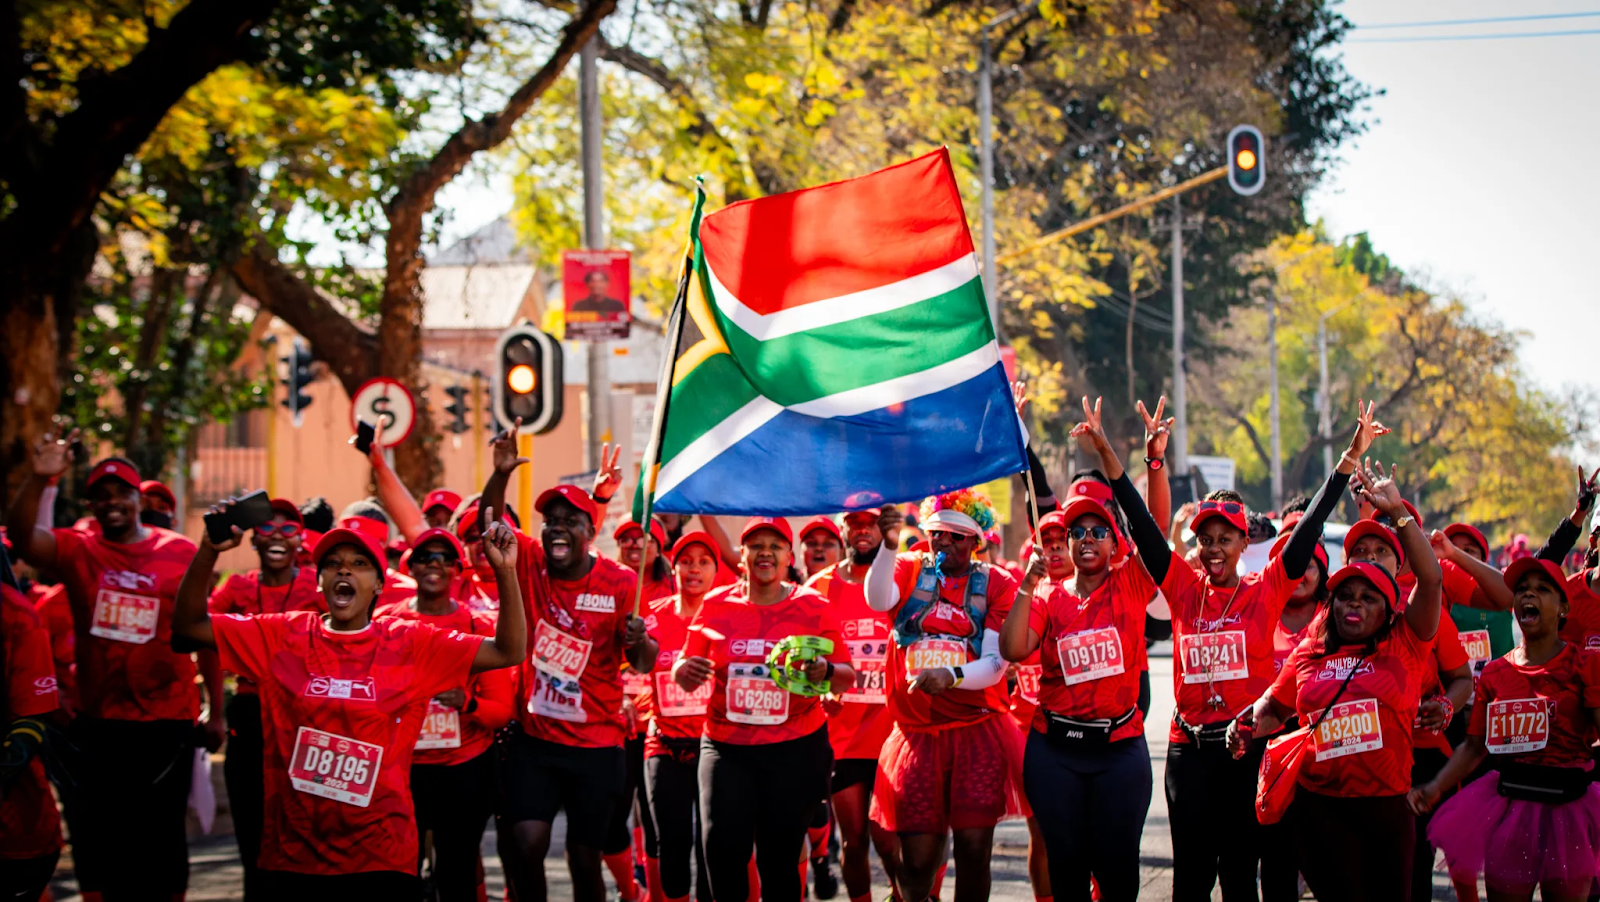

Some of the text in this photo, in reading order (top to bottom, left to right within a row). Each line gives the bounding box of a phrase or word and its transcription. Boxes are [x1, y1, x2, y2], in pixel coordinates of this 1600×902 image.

[371, 397, 395, 430] S
[577, 593, 616, 609] #BONA
[535, 635, 583, 670] C6703
[914, 649, 960, 669] B2531
[1068, 641, 1117, 668] D9175
[1189, 644, 1238, 668] D8241
[1090, 661, 1109, 671] 2024
[735, 689, 783, 710] C6268
[1066, 730, 1083, 739] AVIS
[1321, 713, 1372, 743] B3200
[1490, 712, 1546, 738] E11772
[1342, 736, 1362, 747] 2024
[1511, 735, 1530, 743] 2024
[303, 745, 370, 785] D8195
[324, 777, 349, 790] 2024
